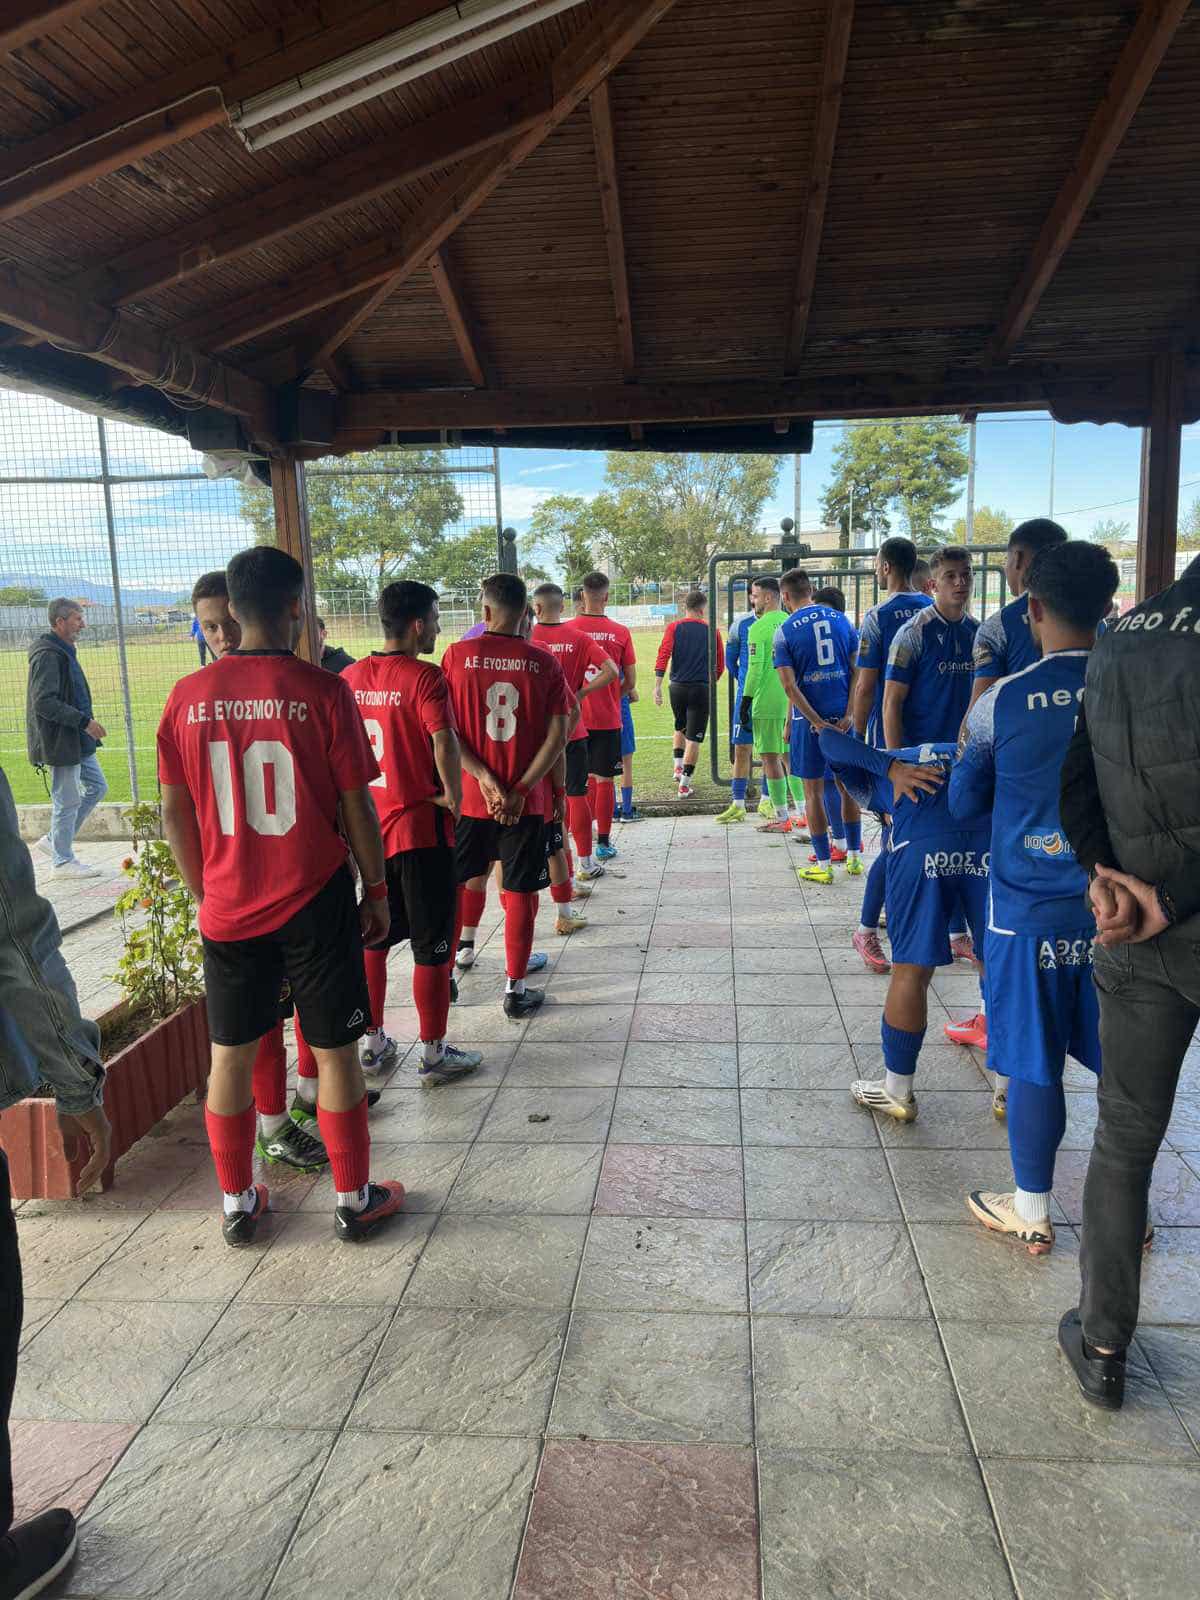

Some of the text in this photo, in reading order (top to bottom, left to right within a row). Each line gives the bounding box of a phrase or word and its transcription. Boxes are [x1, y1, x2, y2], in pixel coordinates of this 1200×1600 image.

[1114, 612, 1164, 633] neo
[812, 619, 835, 666] 6
[483, 657, 527, 671] ΕΥΟΣΜΟΥ
[528, 660, 540, 673] FC
[389, 691, 401, 706] FC
[214, 699, 284, 721] ΕΥΟΣΜΟΥ
[288, 701, 307, 722] FC
[485, 681, 520, 742] 8
[208, 740, 297, 836] 10
[924, 851, 976, 870] ΑΘΩΣ
